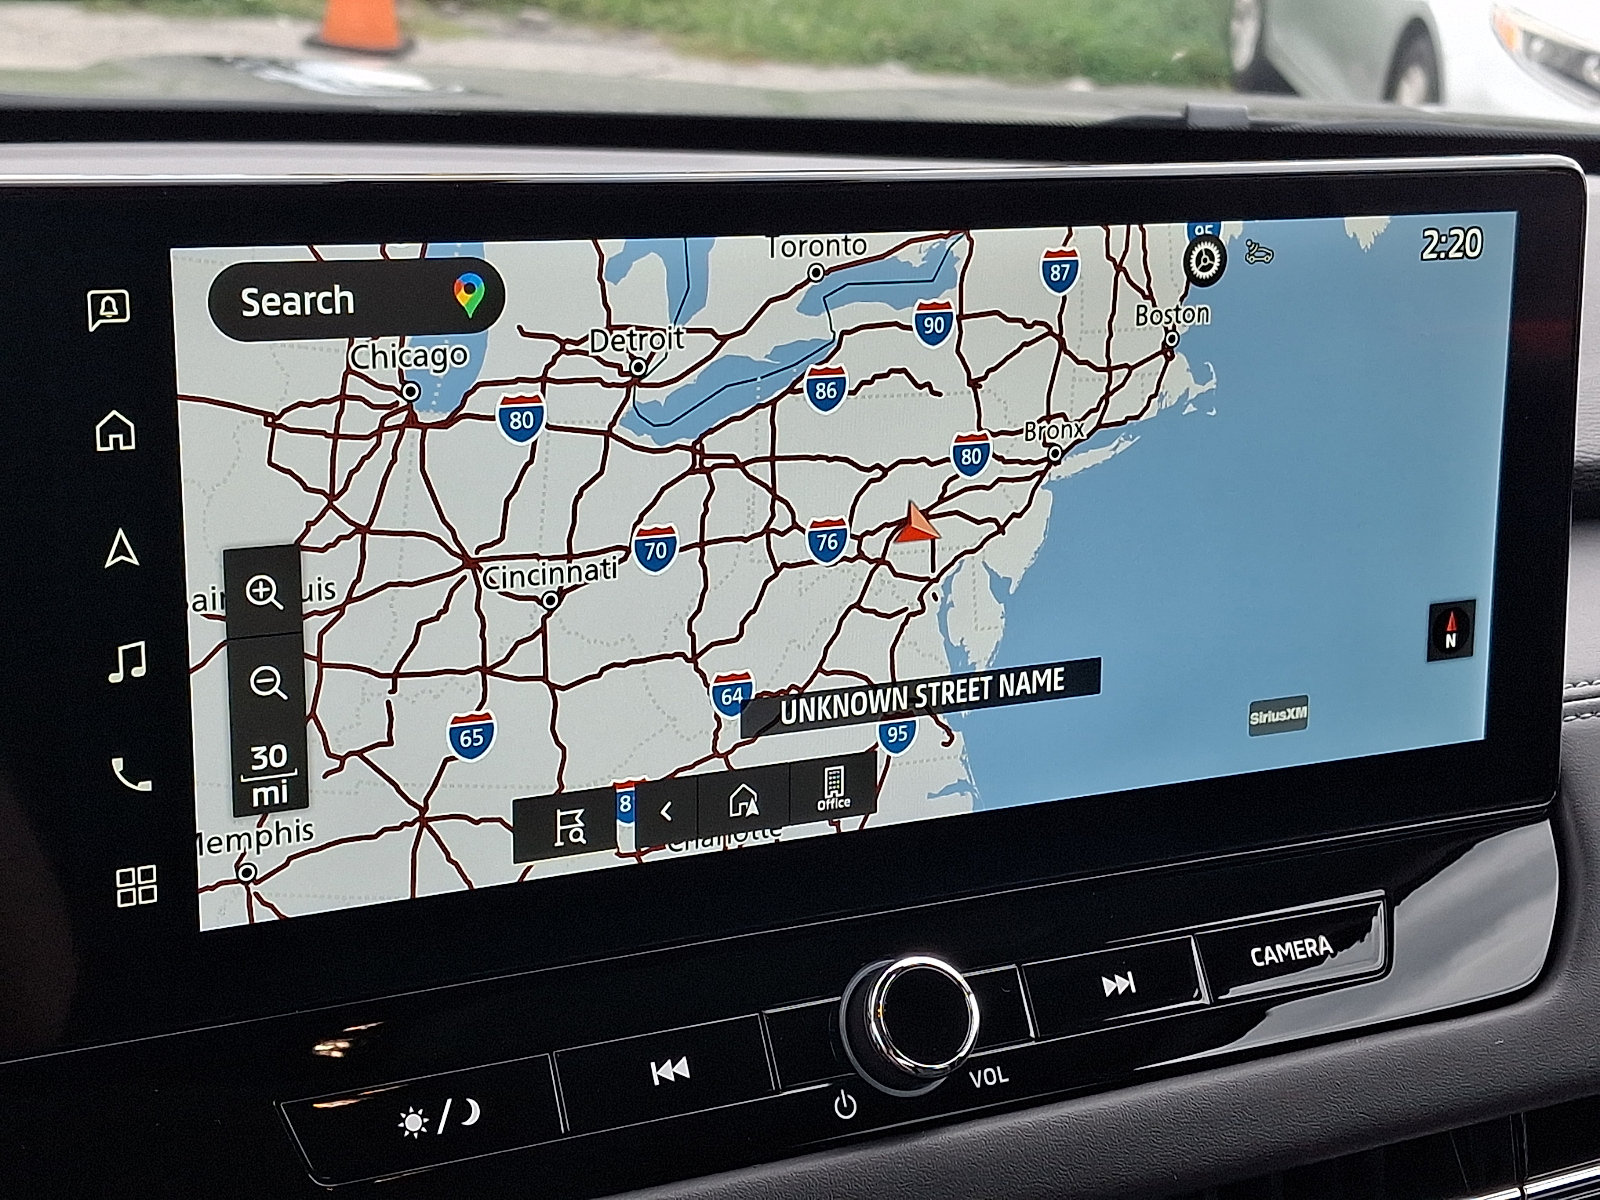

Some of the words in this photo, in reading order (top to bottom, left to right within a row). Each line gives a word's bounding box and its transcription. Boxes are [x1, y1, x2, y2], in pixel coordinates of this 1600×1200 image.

[765, 235, 867, 258] Toronto
[1421, 227, 1483, 261] 2:20
[1050, 264, 1070, 282] 87
[241, 284, 355, 317] Search
[923, 316, 945, 335] 90
[1136, 304, 1210, 327] Boston
[590, 326, 685, 354] Detroit
[351, 342, 468, 373] Chicago
[815, 381, 838, 400] 86
[510, 411, 535, 430] 80
[1024, 421, 1085, 441] Bronx
[961, 447, 982, 466] 80
[645, 541, 668, 560] 70
[815, 533, 838, 551] 76
[483, 556, 618, 590] Cincinnati
[302, 577, 336, 602] uis
[1445, 633, 1456, 649] N
[721, 689, 744, 706] 64
[780, 685, 908, 726] UNKNOWN
[914, 676, 993, 708] STREET
[998, 666, 1066, 697] NAME
[1250, 705, 1308, 726] SiriusXM
[459, 728, 485, 748] 65
[887, 724, 909, 743] 95
[251, 745, 288, 770] 30
[252, 781, 288, 808] mi
[619, 795, 632, 812] 8
[817, 798, 851, 811] Office
[1250, 934, 1335, 968] CAMERA
[969, 1065, 1010, 1090] VOL
